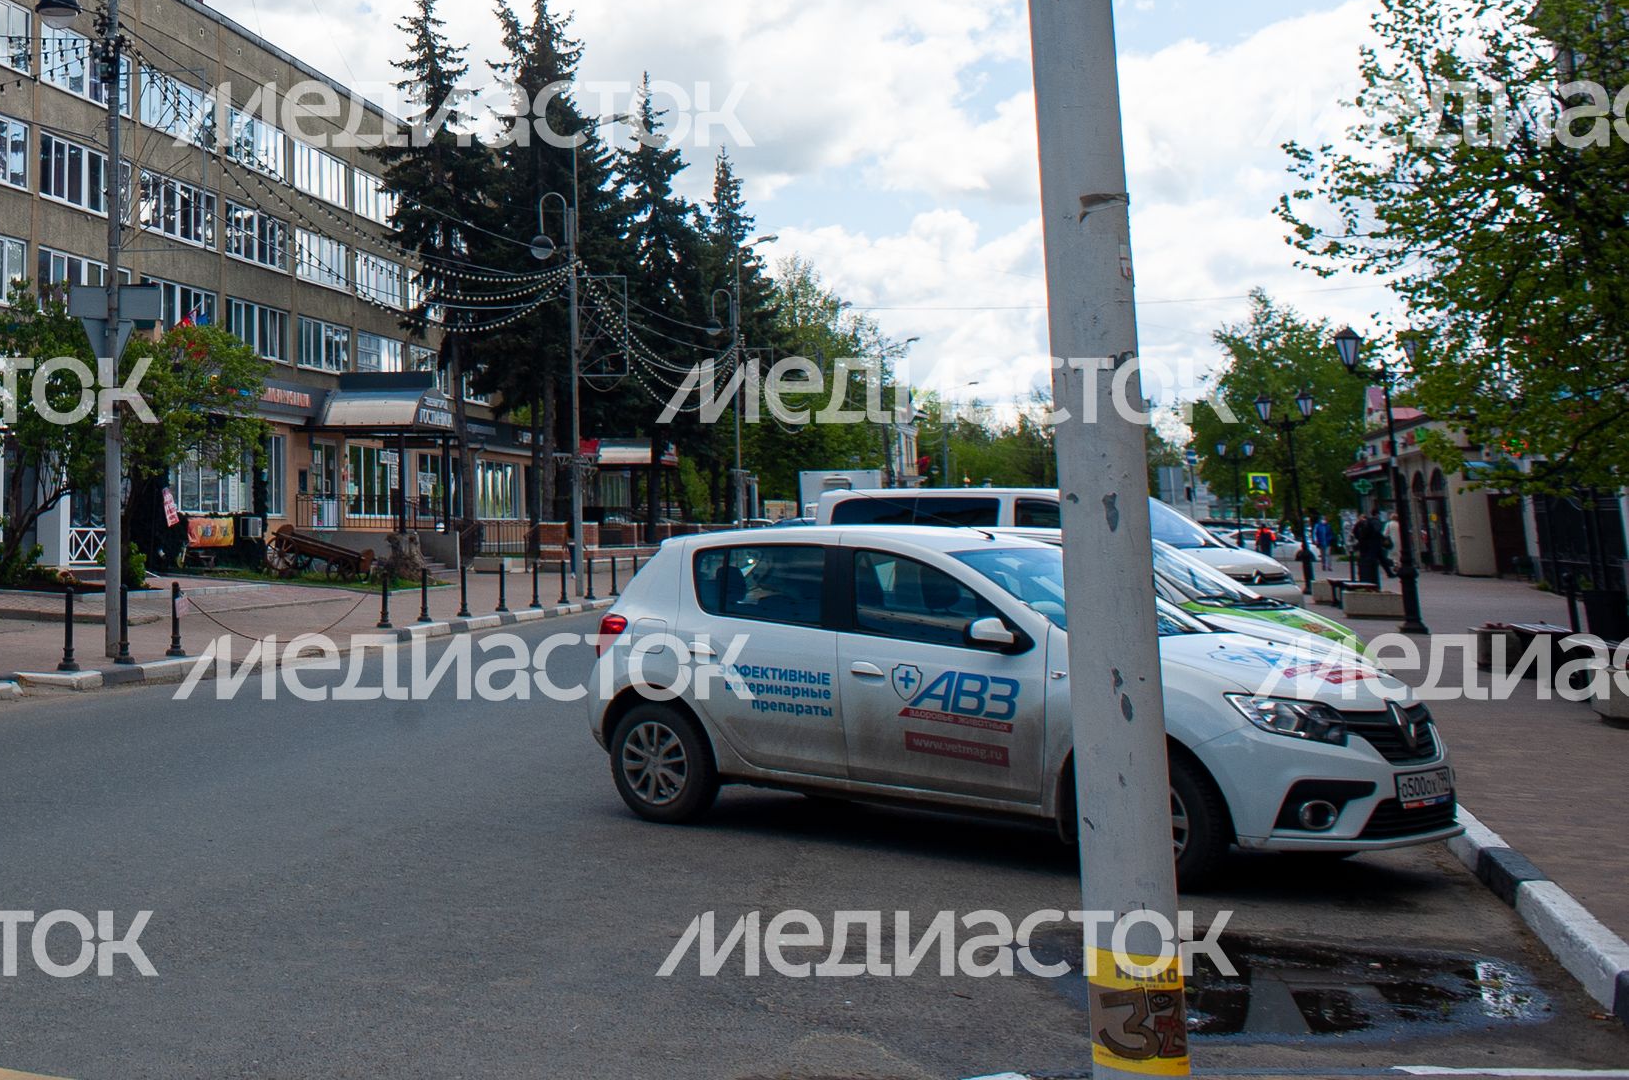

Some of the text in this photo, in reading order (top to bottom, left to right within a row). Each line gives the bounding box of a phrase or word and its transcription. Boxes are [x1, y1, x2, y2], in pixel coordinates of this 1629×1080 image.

[718, 664, 831, 686] ЭФФЕКТИВНЫЕ
[725, 681, 831, 700] ветеринарные
[909, 670, 1020, 721] АВЗ
[752, 699, 833, 717] препараты
[912, 737, 1003, 761] www.vetmag.ru
[1115, 965, 1178, 983] HELLO
